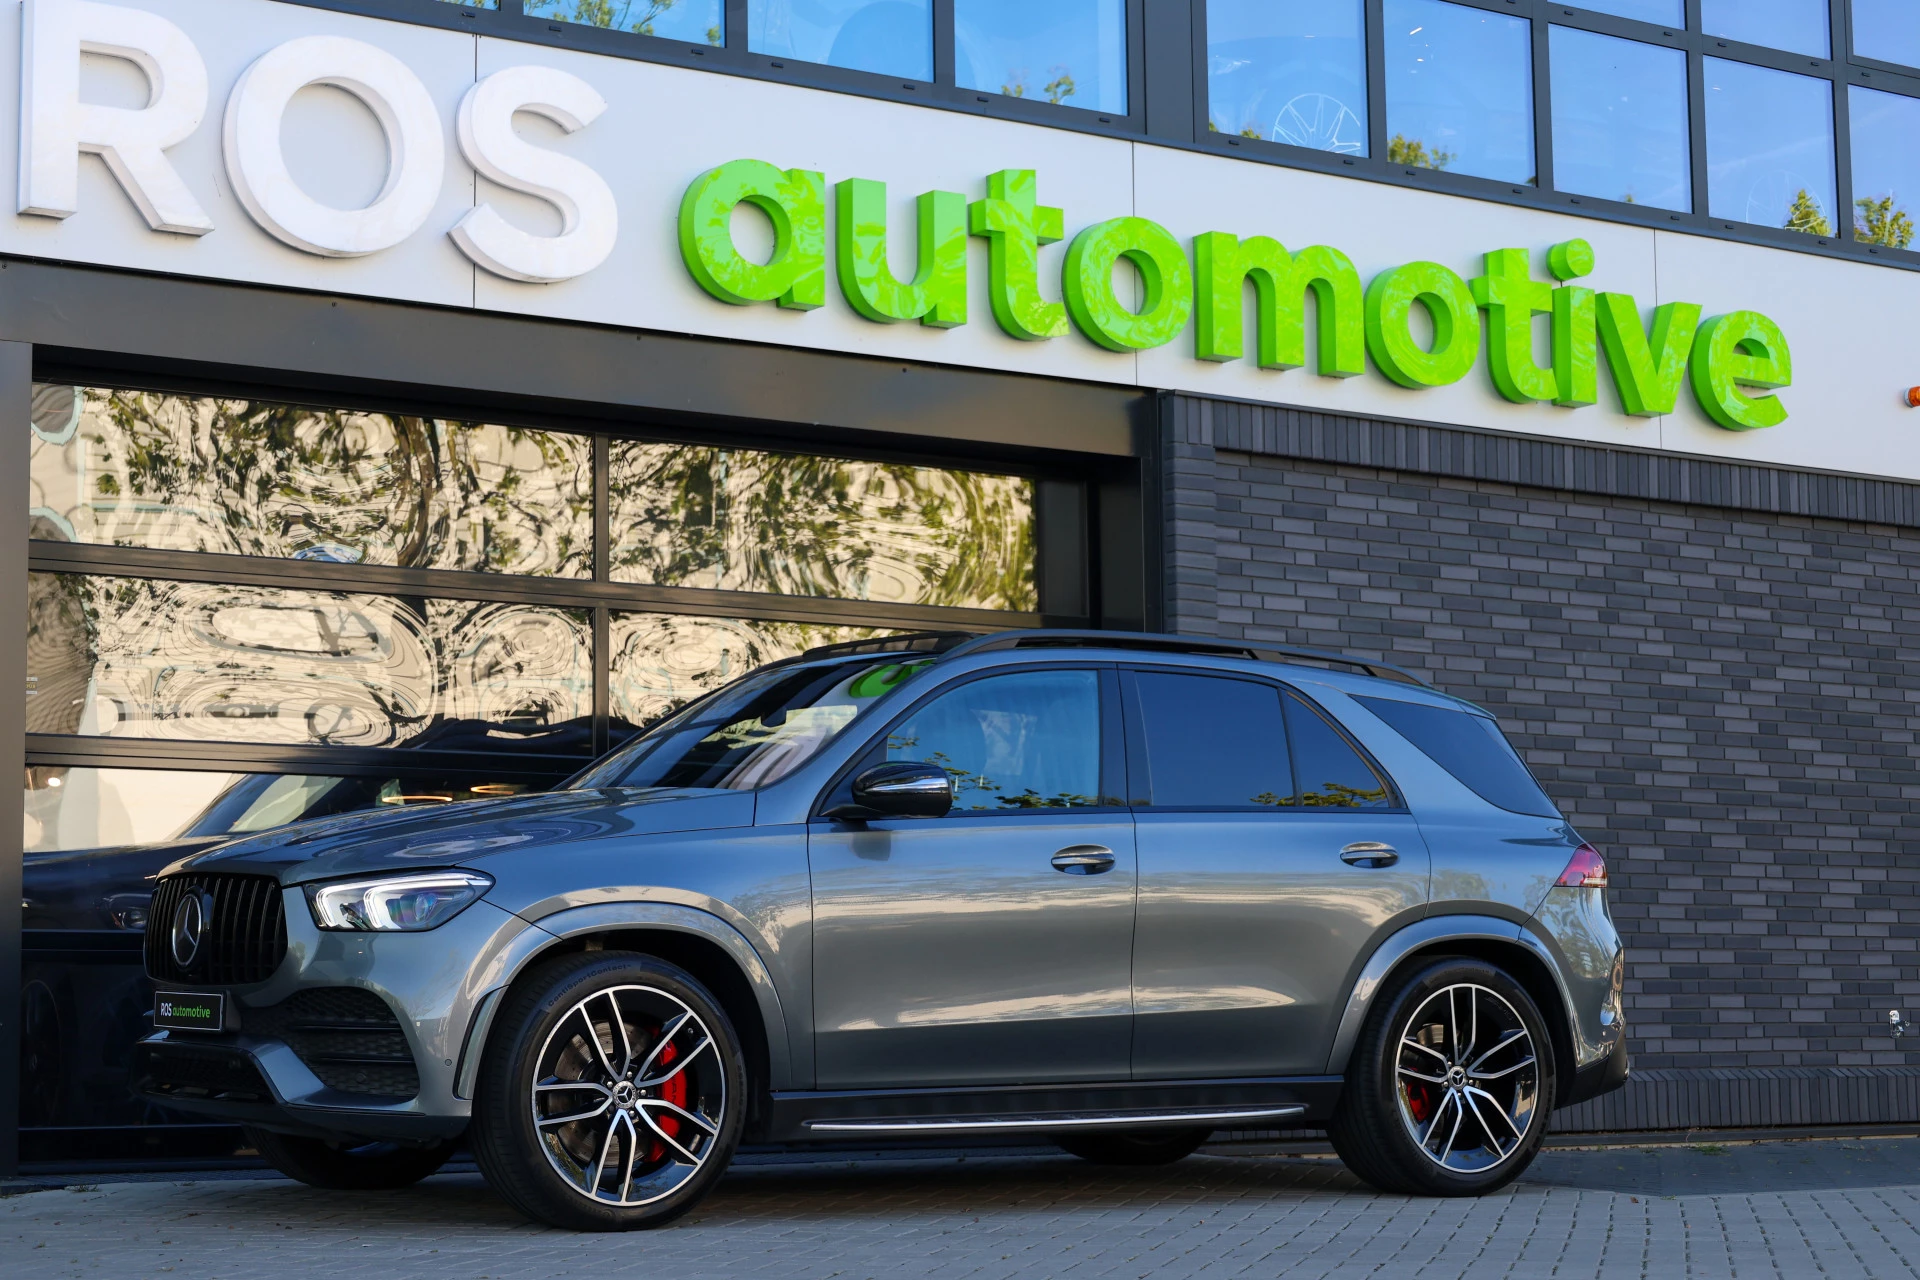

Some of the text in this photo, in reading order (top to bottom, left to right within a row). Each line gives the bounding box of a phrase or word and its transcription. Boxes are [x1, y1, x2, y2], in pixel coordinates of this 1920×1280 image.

[17, 0, 1792, 432] ROS automotive
[160, 1002, 211, 1018] ROS automotive
